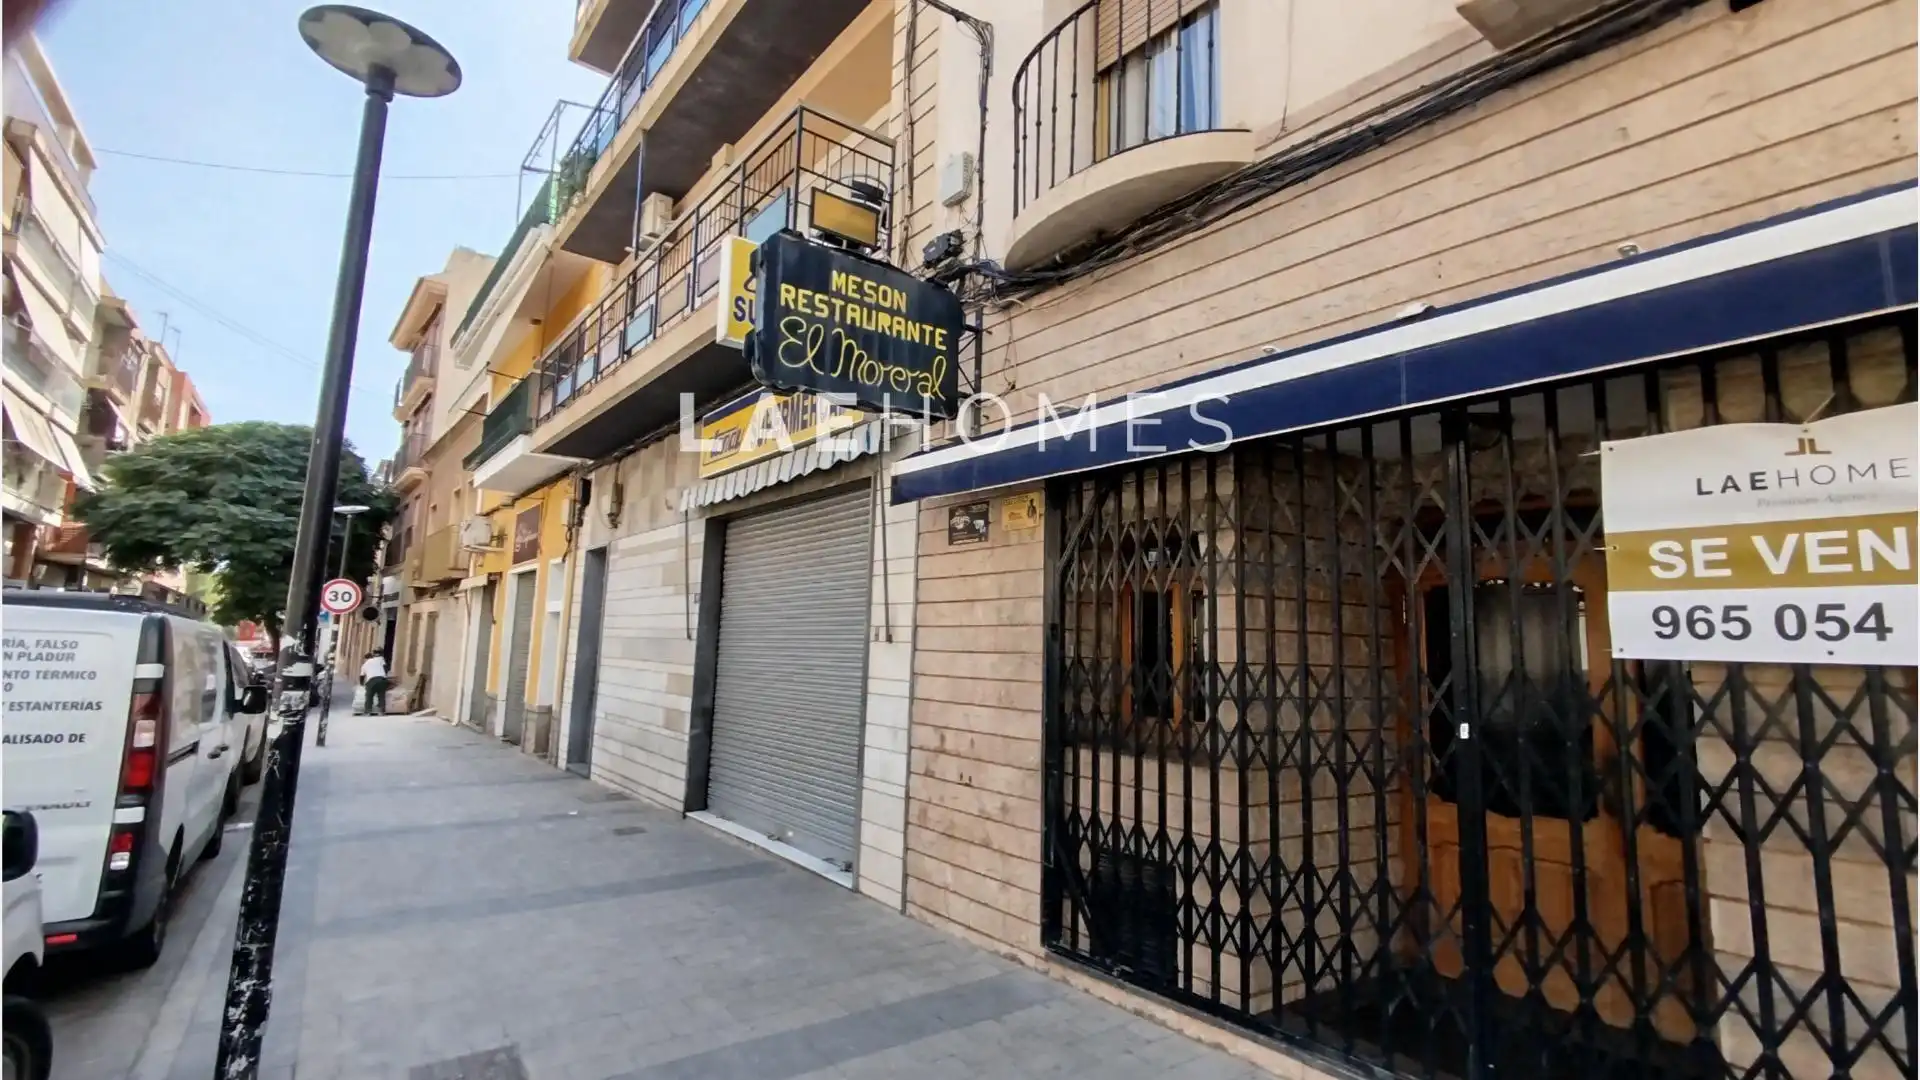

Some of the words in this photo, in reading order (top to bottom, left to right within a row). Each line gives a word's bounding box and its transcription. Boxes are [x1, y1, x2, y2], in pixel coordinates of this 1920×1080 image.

[832, 270, 907, 313] MESON
[780, 283, 948, 351] RESTAURANTE
[778, 316, 824, 375] El
[1696, 458, 1912, 496] LAEHOME
[1648, 537, 1732, 579] SE
[1750, 526, 1911, 575] VEN
[328, 590, 352, 602] 30
[1651, 604, 1752, 641] 965
[1774, 602, 1894, 642] 054
[17, 651, 76, 662] PLADUR
[35, 639, 79, 649] FALSO
[2, 682, 14, 692] O
[2, 734, 64, 744] ALISADO
[67, 733, 86, 743] DE
